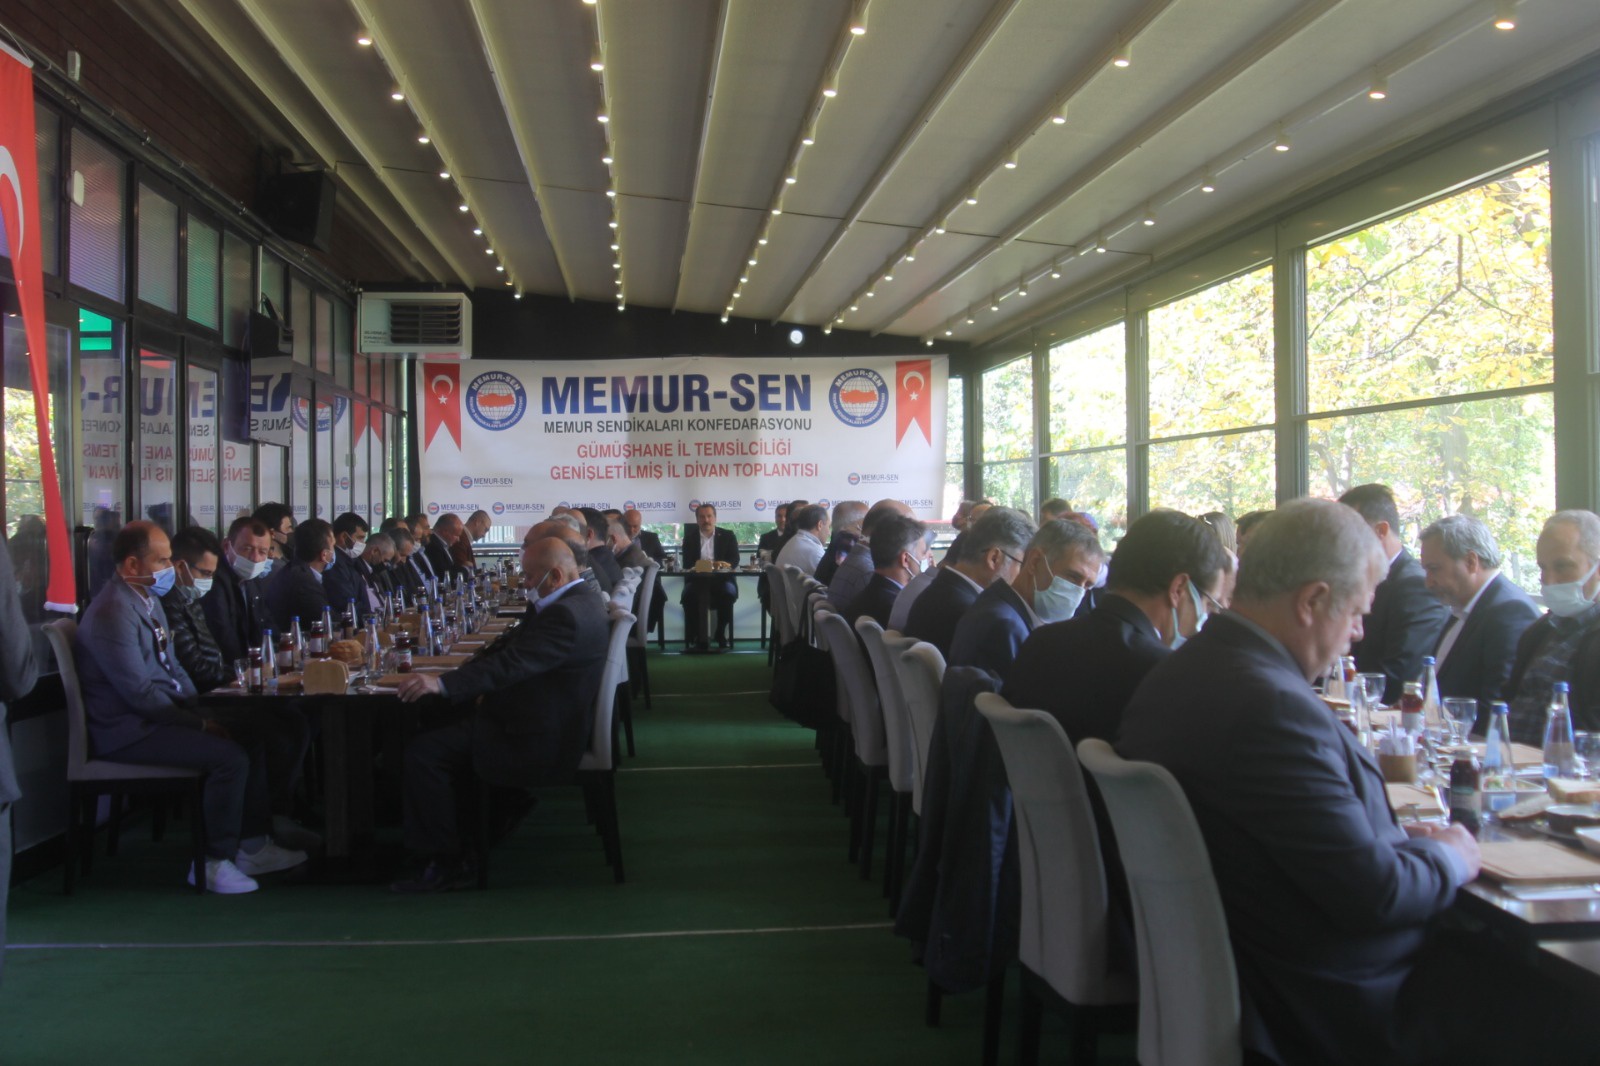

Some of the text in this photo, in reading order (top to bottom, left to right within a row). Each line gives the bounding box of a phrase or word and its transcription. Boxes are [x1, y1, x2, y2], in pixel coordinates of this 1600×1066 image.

[541, 373, 811, 415] MEMUR-SEN
[544, 417, 812, 433] MEMUR SENDİKALARI KONFEDARASYONU
[577, 438, 791, 459] GÜMÜŞHANE İL TEMSİLCİLİĞİ
[550, 460, 818, 481] GENİŞLETİLMİŞ İL DİVAN TOPLANTISI
